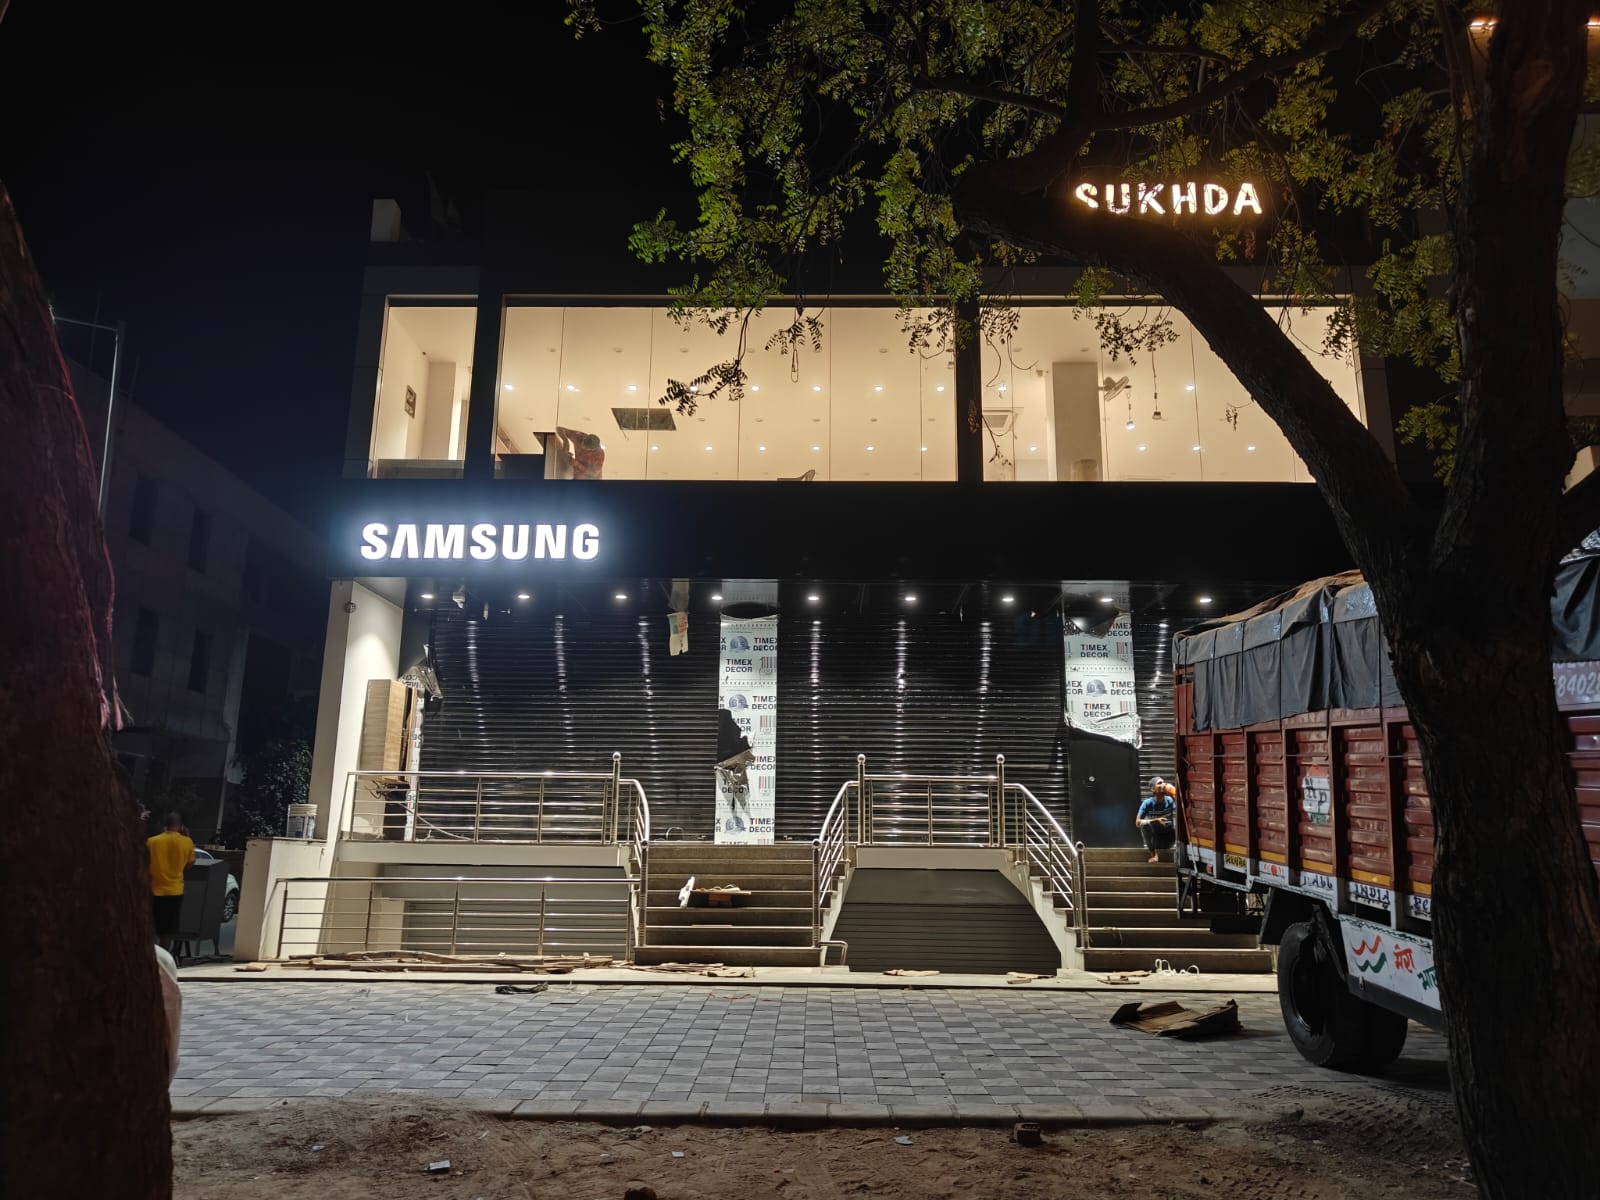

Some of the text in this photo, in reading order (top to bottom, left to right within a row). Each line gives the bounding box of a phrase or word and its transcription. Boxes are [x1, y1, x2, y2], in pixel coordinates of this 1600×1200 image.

[1074, 181, 1263, 215] SUKHDA
[360, 522, 600, 560] SAMSUNG
[1354, 884, 1390, 904] INDIA
